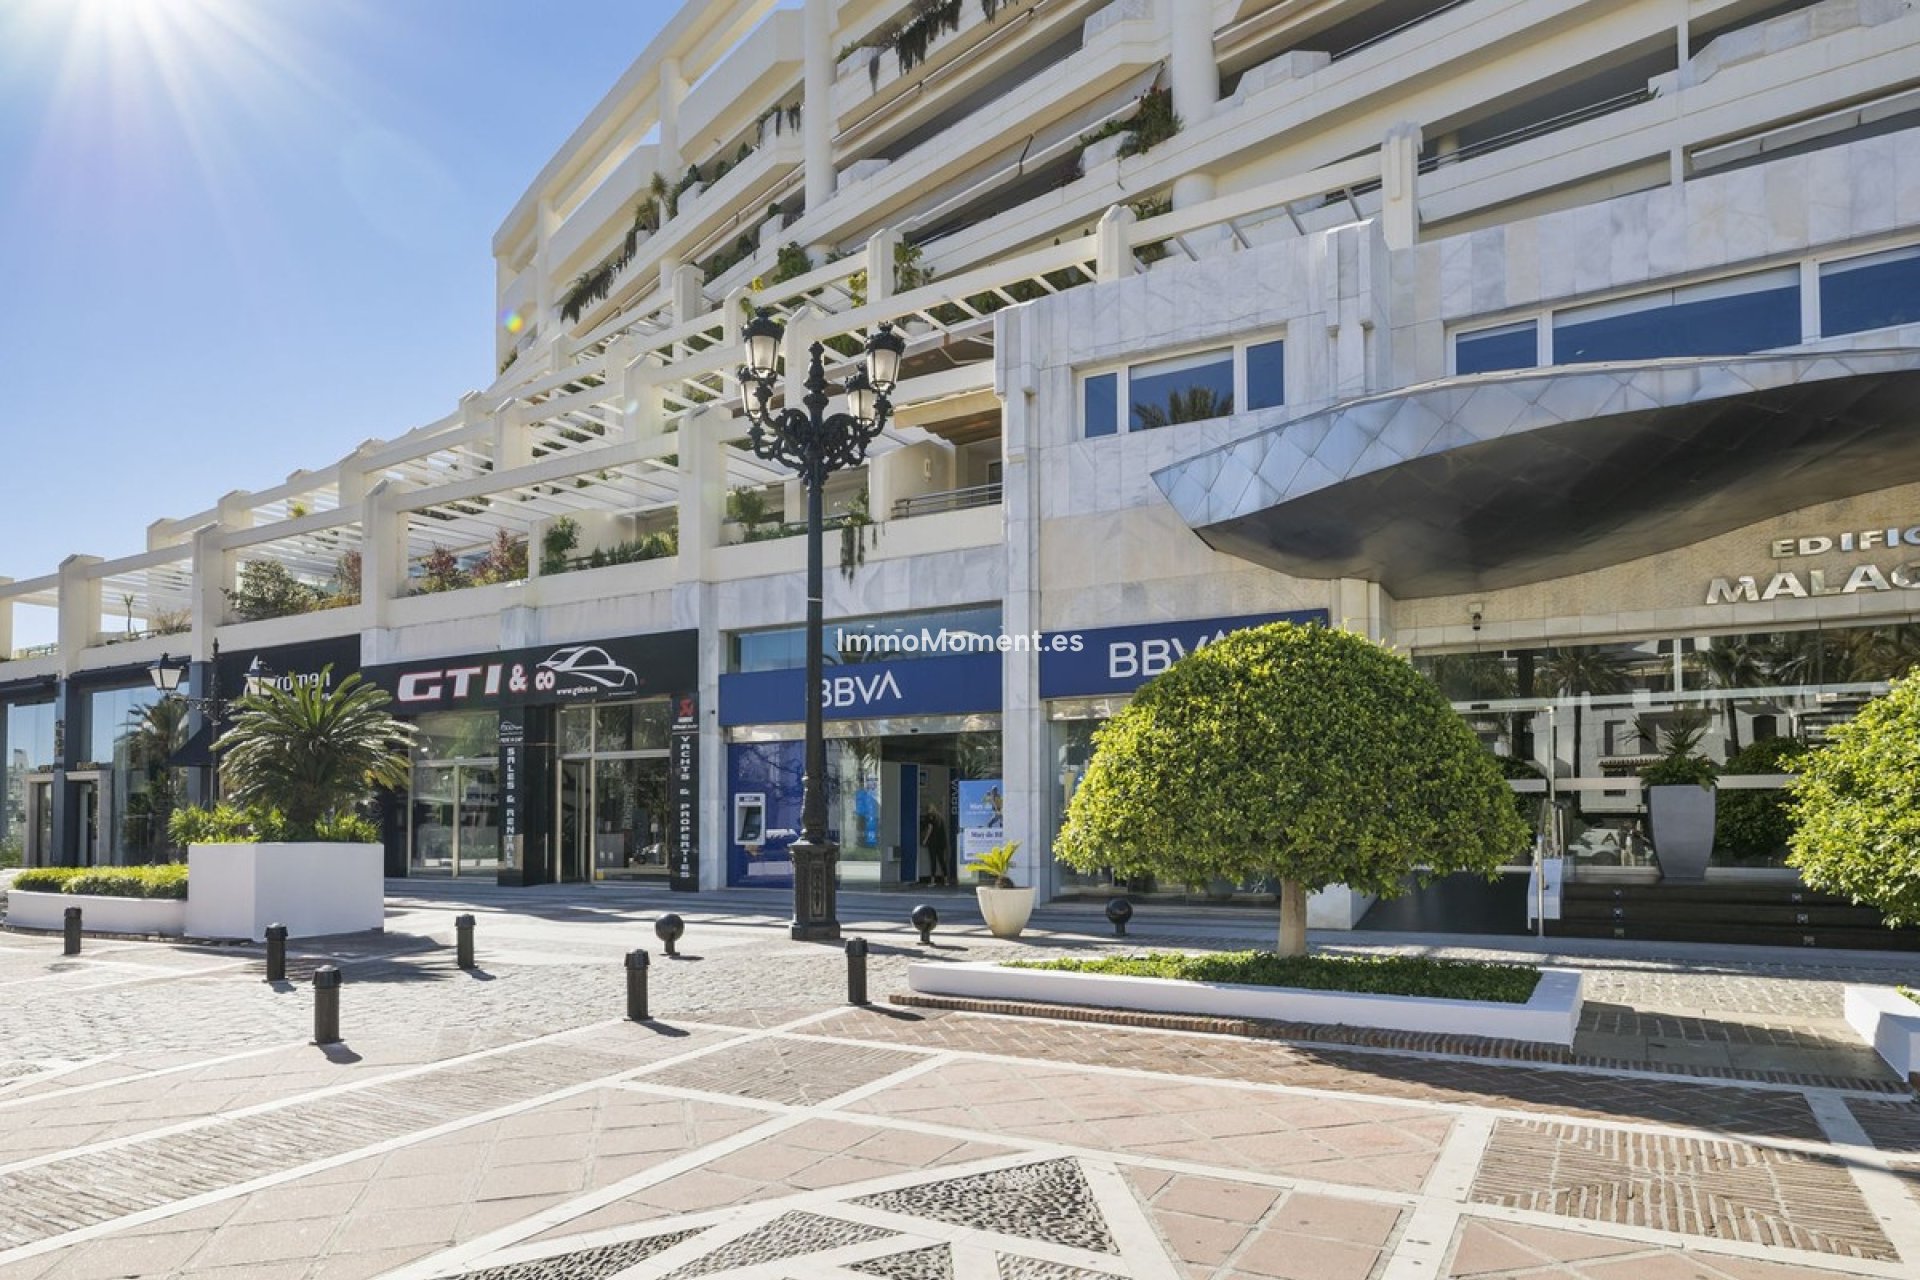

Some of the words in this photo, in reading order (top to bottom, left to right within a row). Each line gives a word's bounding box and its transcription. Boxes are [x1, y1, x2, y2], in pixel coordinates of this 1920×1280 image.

[1109, 629, 1225, 678] BBV
[397, 663, 504, 702] GTI
[508, 663, 528, 693] &
[506, 747, 515, 790] SALES
[680, 736, 690, 780] YACHTS
[506, 809, 515, 869] RENTALS
[680, 803, 690, 878] PROPERTIES
